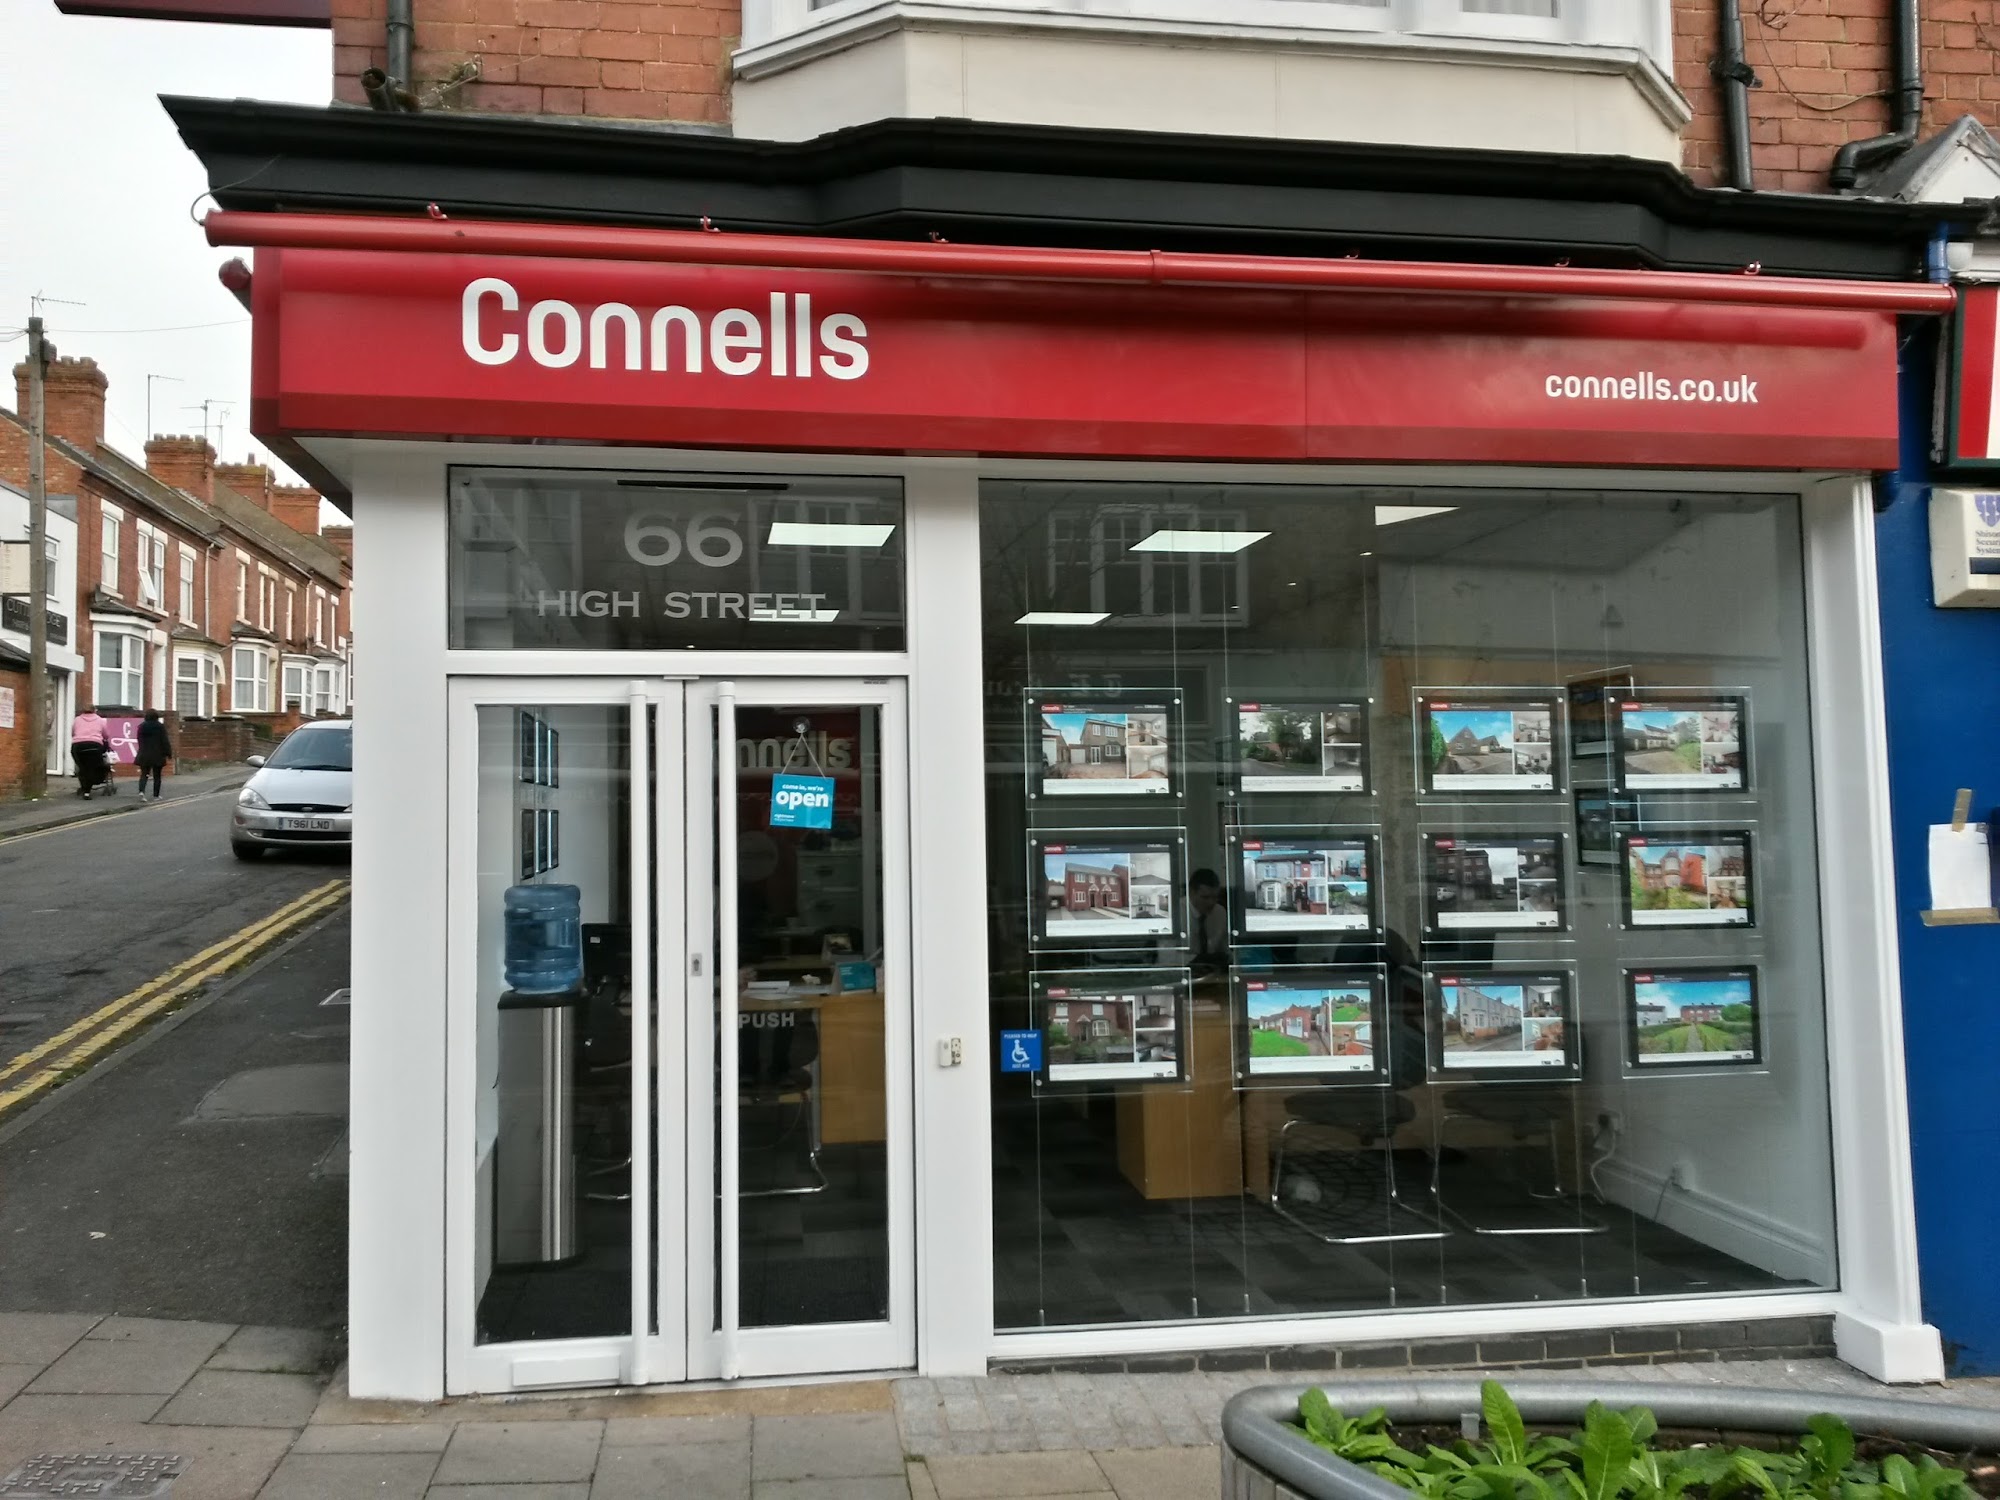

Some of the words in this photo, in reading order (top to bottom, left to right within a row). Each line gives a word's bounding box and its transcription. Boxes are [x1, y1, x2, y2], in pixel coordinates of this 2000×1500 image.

[461, 277, 869, 380] Connells
[1545, 371, 1758, 403] connells.co.uk
[624, 509, 743, 567] 66
[537, 590, 641, 618] HIGH
[663, 591, 826, 619] STREET
[736, 731, 851, 768] nnells
[775, 791, 829, 810] open
[287, 819, 309, 829] T961
[310, 820, 330, 830] LND
[738, 1011, 795, 1029] PUSH
